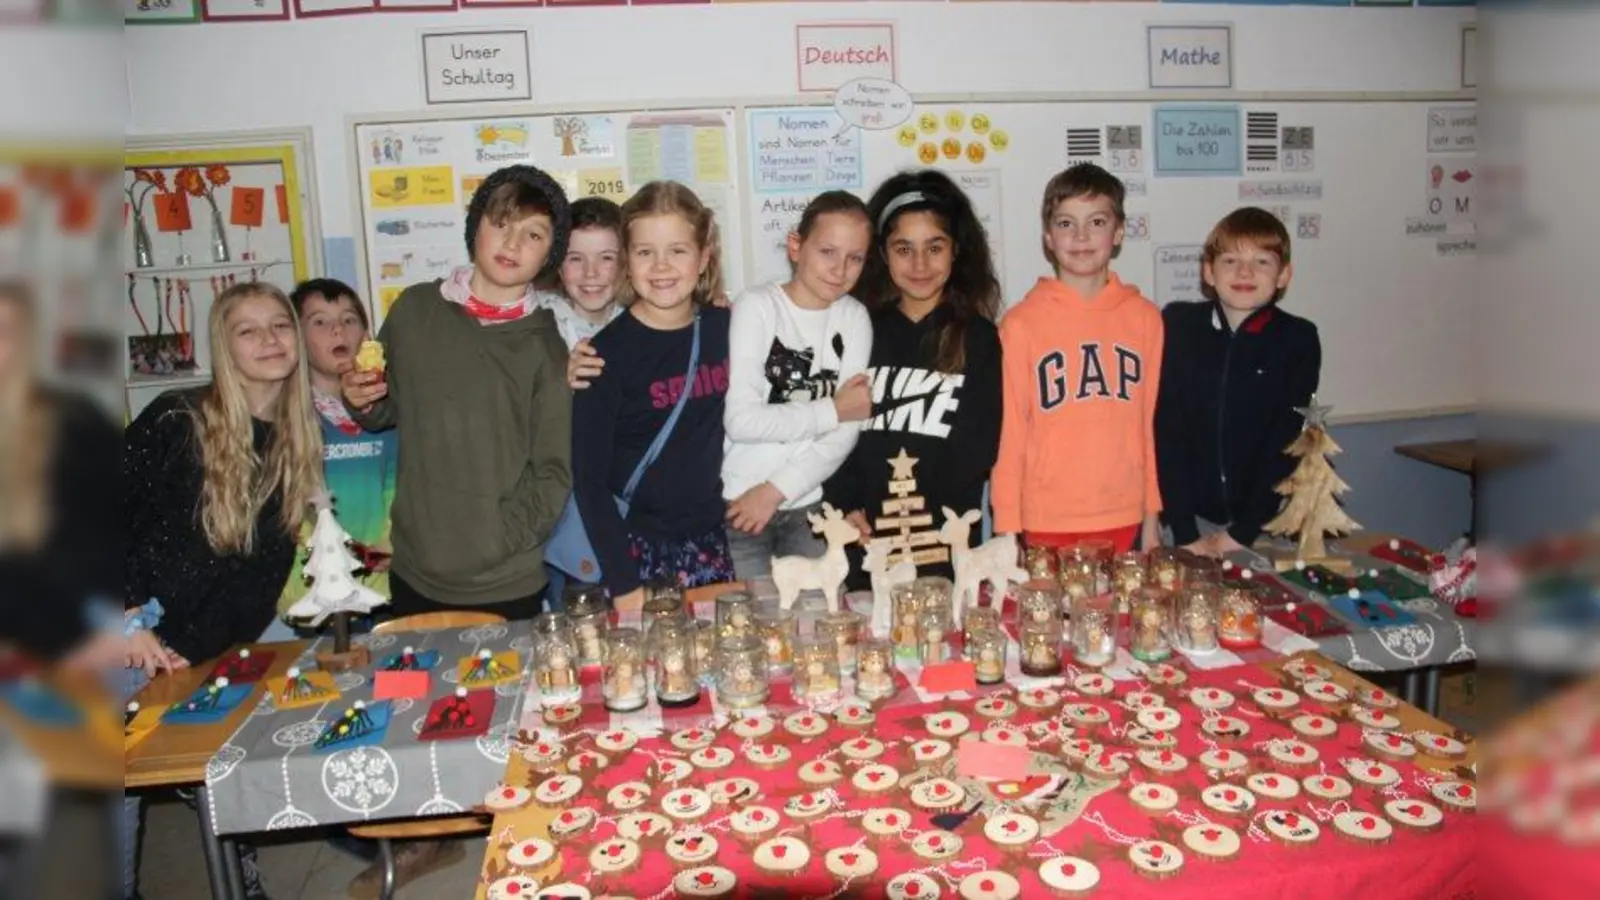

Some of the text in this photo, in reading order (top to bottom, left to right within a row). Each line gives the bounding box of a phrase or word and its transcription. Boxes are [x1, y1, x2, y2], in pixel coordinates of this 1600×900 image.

[451, 44, 501, 60] Unser
[805, 44, 889, 65] Deutsch
[1161, 46, 1221, 66] Mathe
[441, 68, 515, 90] Schultag
[778, 116, 829, 130] Nomen
[1162, 122, 1232, 136] Die Zahlen
[758, 137, 782, 149] sind
[788, 137, 828, 149] Nomen
[1176, 141, 1219, 156] bis 100
[484, 151, 530, 163] Dezember
[760, 151, 856, 166] Menschen Tiere
[761, 168, 857, 185] Pflanzen Dinge
[588, 180, 625, 195] 2019
[243, 193, 256, 214] 5
[1454, 196, 1469, 214] M
[1126, 216, 1148, 239] 58
[1298, 214, 1320, 238] 85
[1037, 343, 1142, 411] GAP
